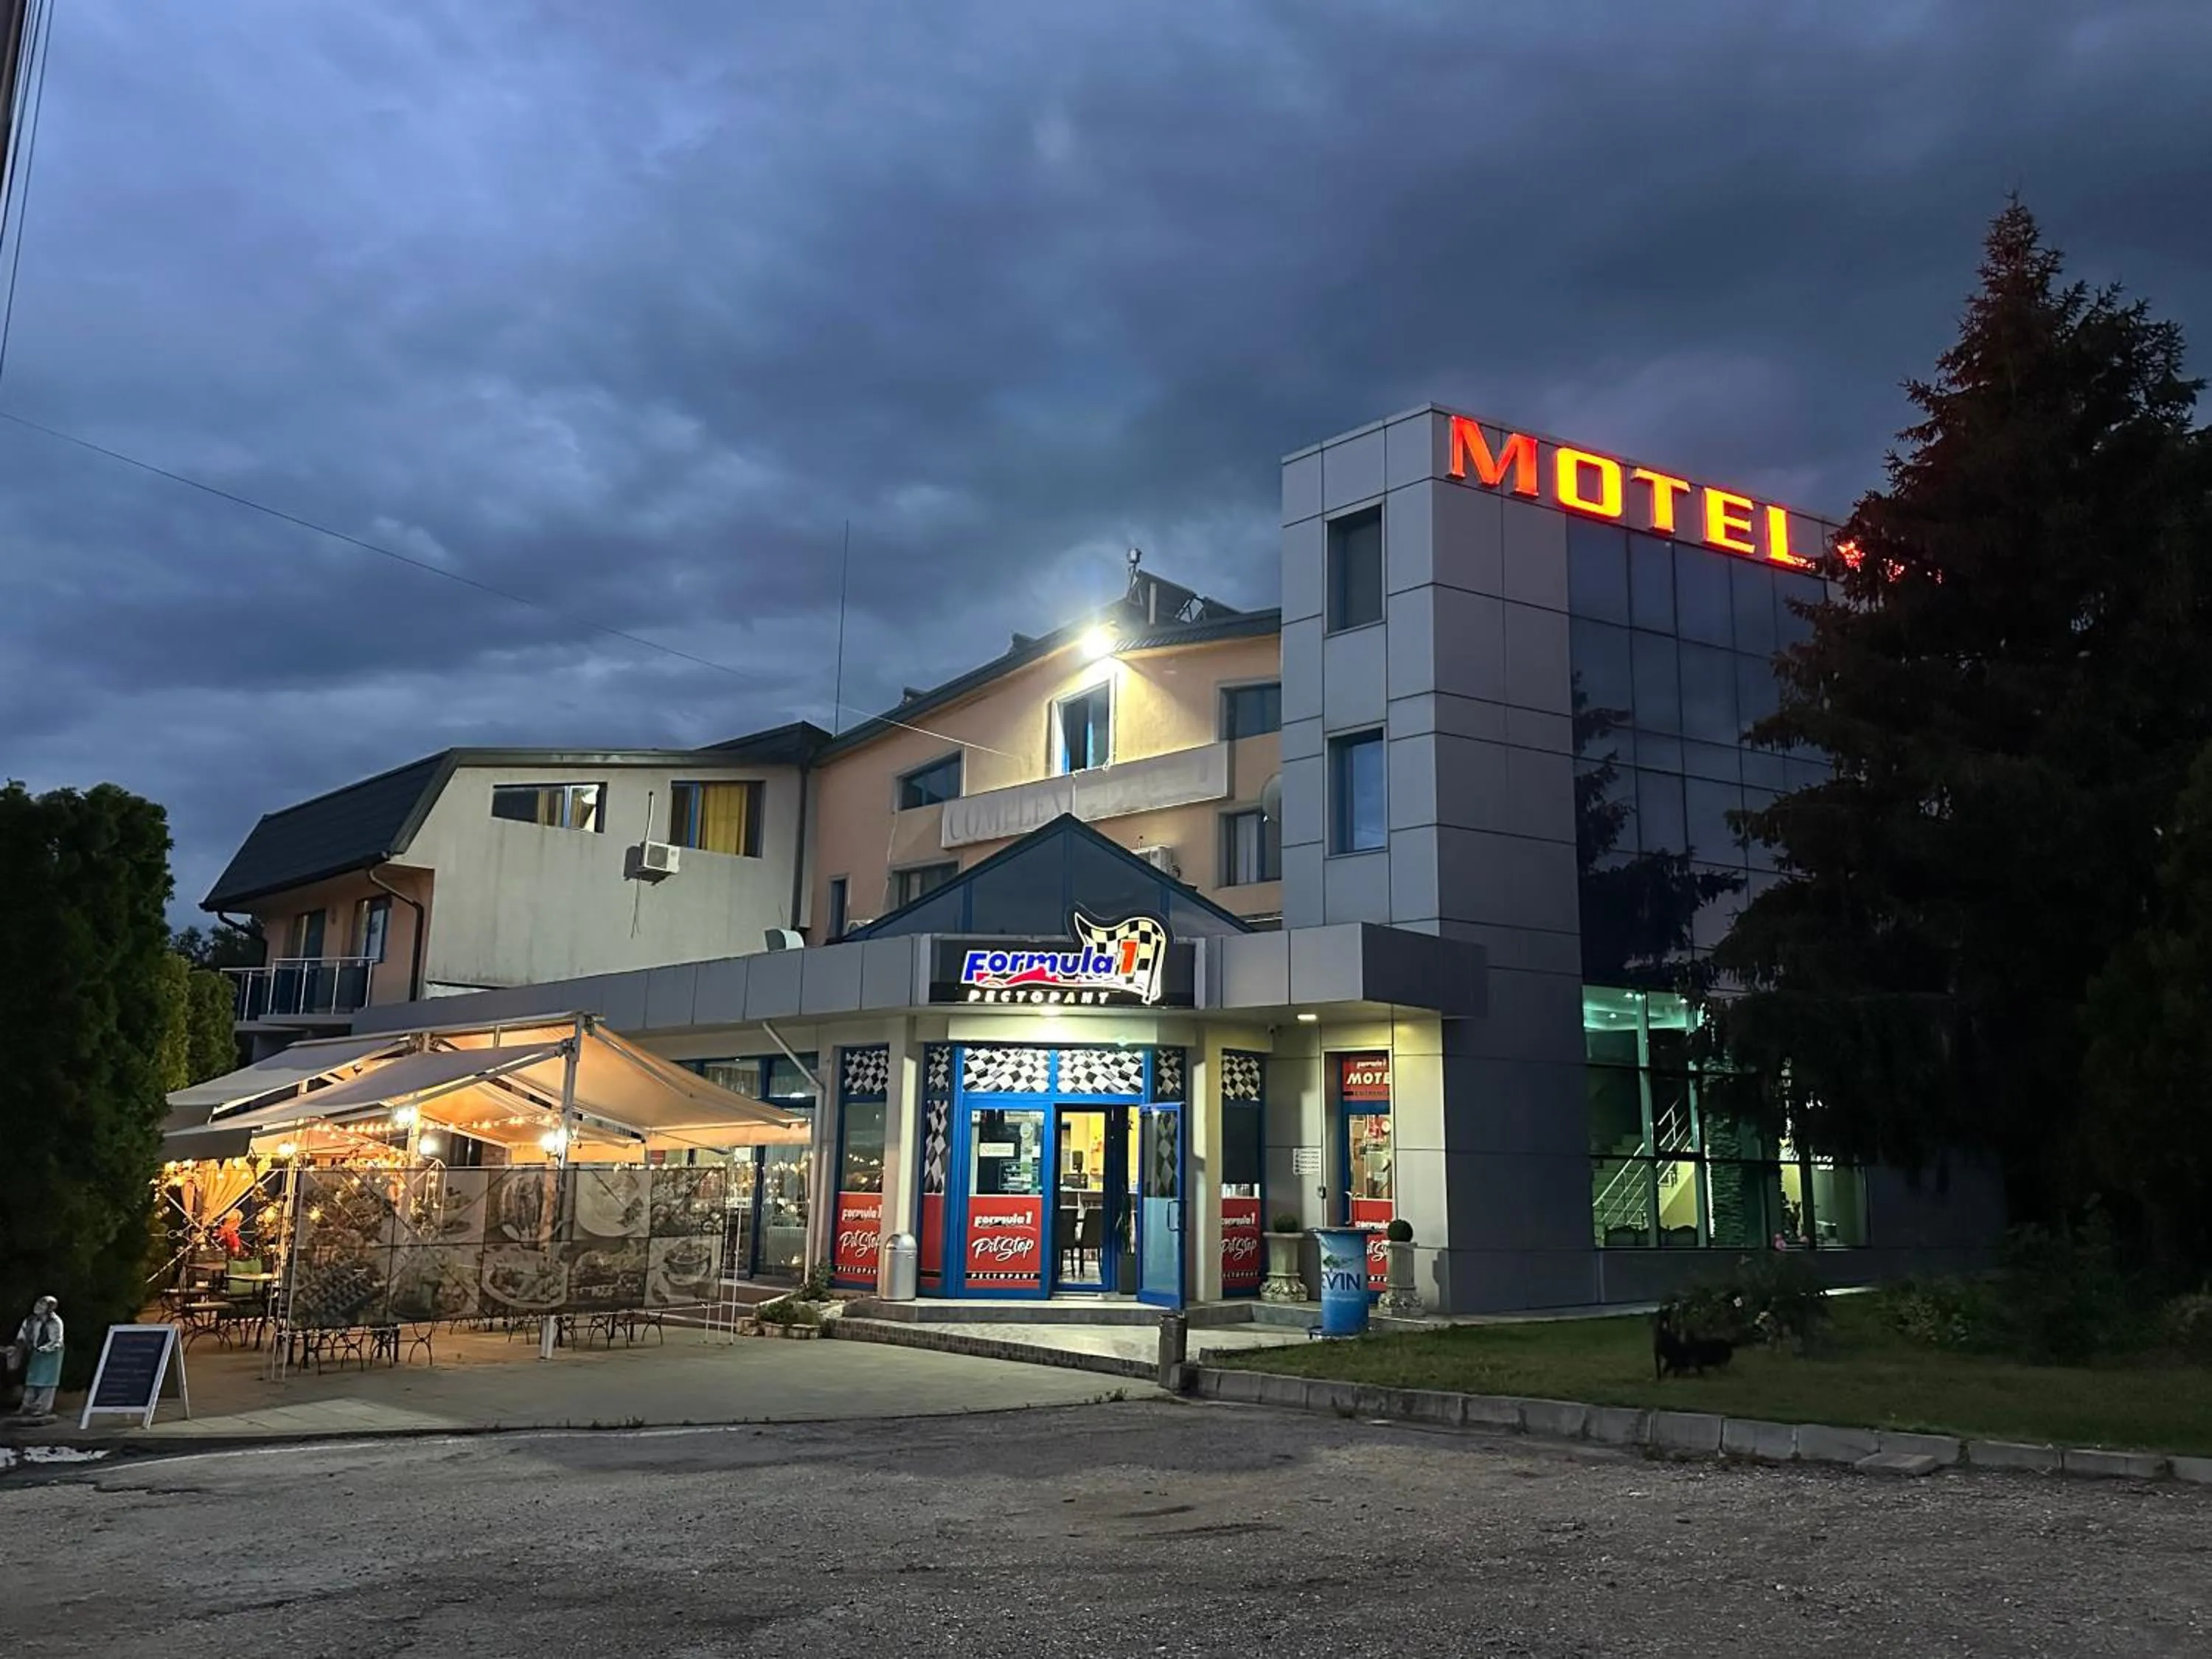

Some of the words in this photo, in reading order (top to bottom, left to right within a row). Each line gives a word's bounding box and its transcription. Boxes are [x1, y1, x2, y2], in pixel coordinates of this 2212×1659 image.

[1447, 416, 1817, 570] MOTEL
[961, 946, 1114, 984] Formula
[1119, 939, 1140, 976] 1
[967, 990, 1110, 1004] РЕСТОРАНТ
